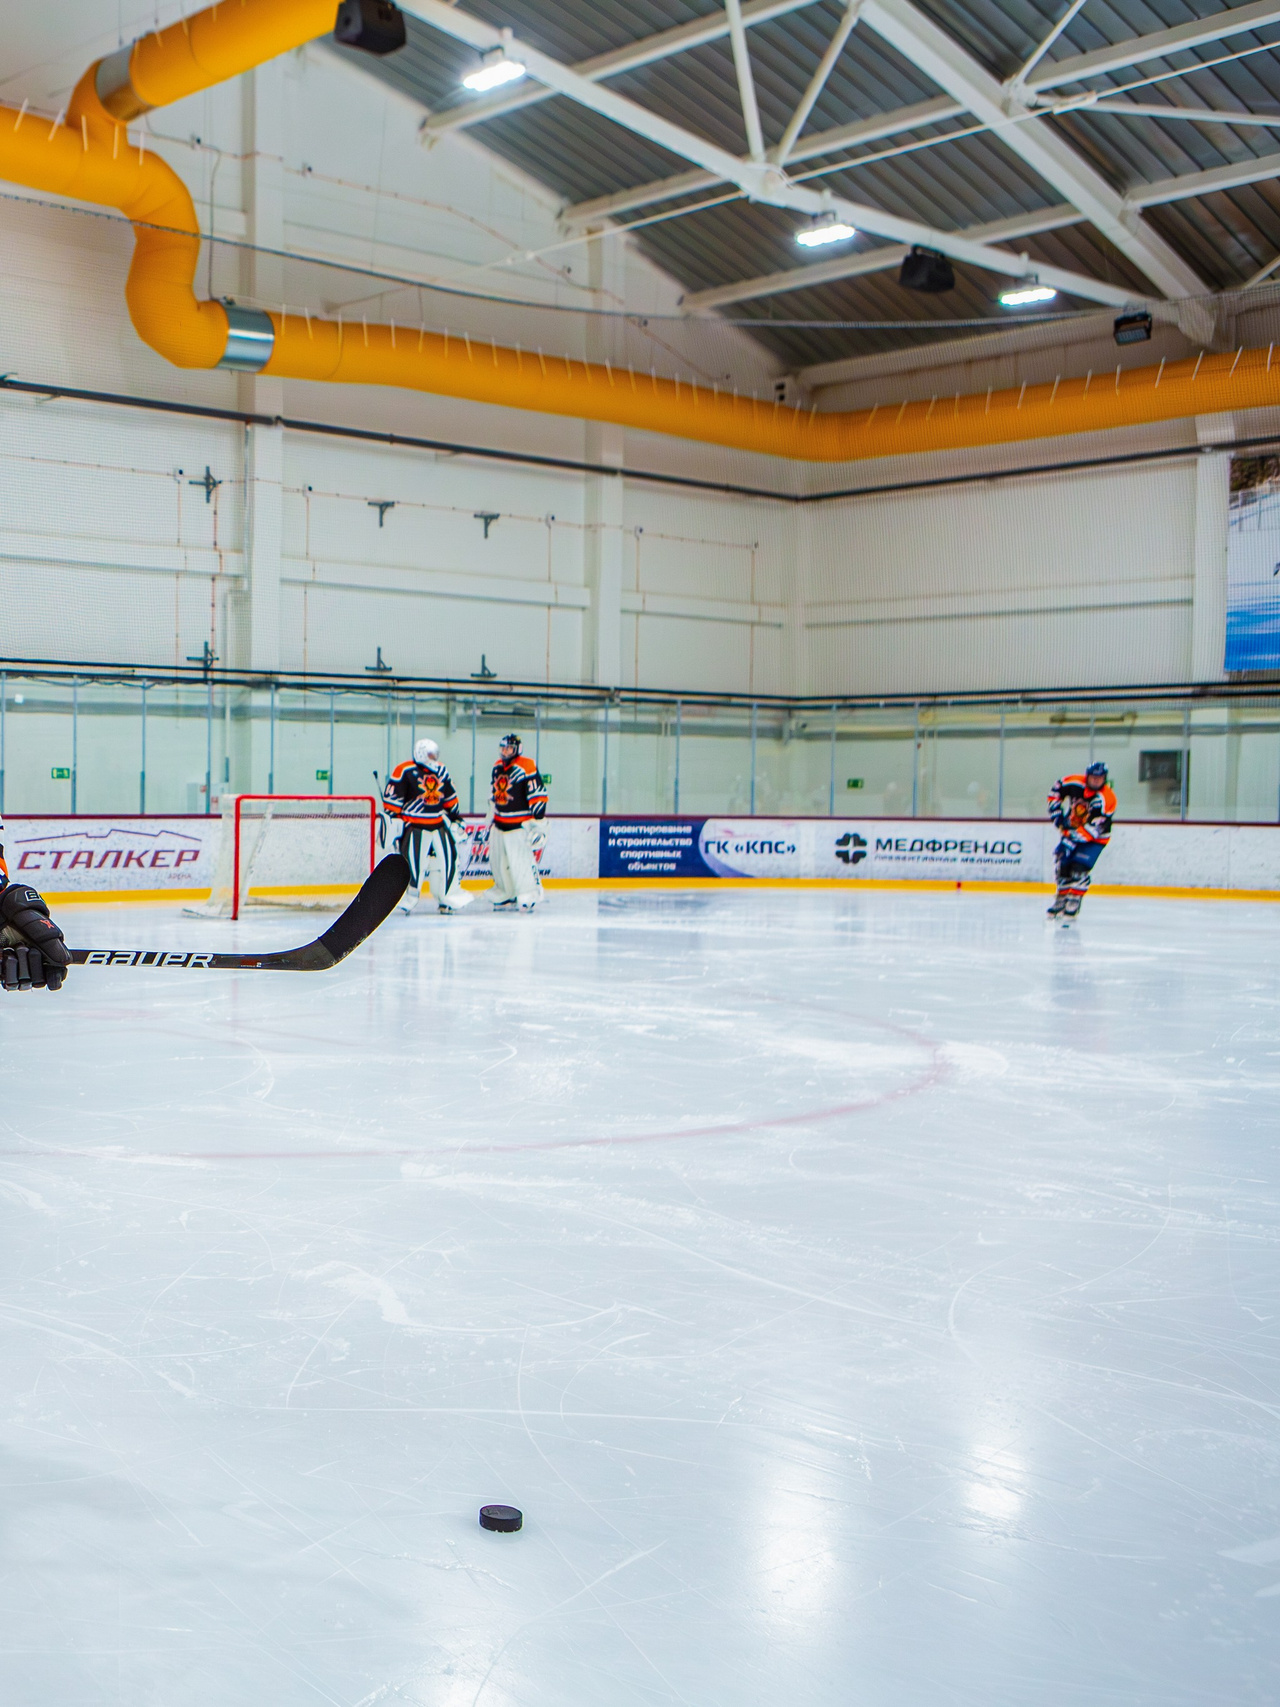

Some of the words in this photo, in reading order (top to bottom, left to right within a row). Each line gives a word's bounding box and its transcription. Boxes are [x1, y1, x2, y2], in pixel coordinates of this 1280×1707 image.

[705, 841, 729, 854] ГК
[735, 841, 797, 854] «КПС»
[875, 838, 1022, 854] МЕДФРЕНДС
[17, 850, 200, 870] СТАЛКЕР
[84, 951, 214, 968] BAUER
